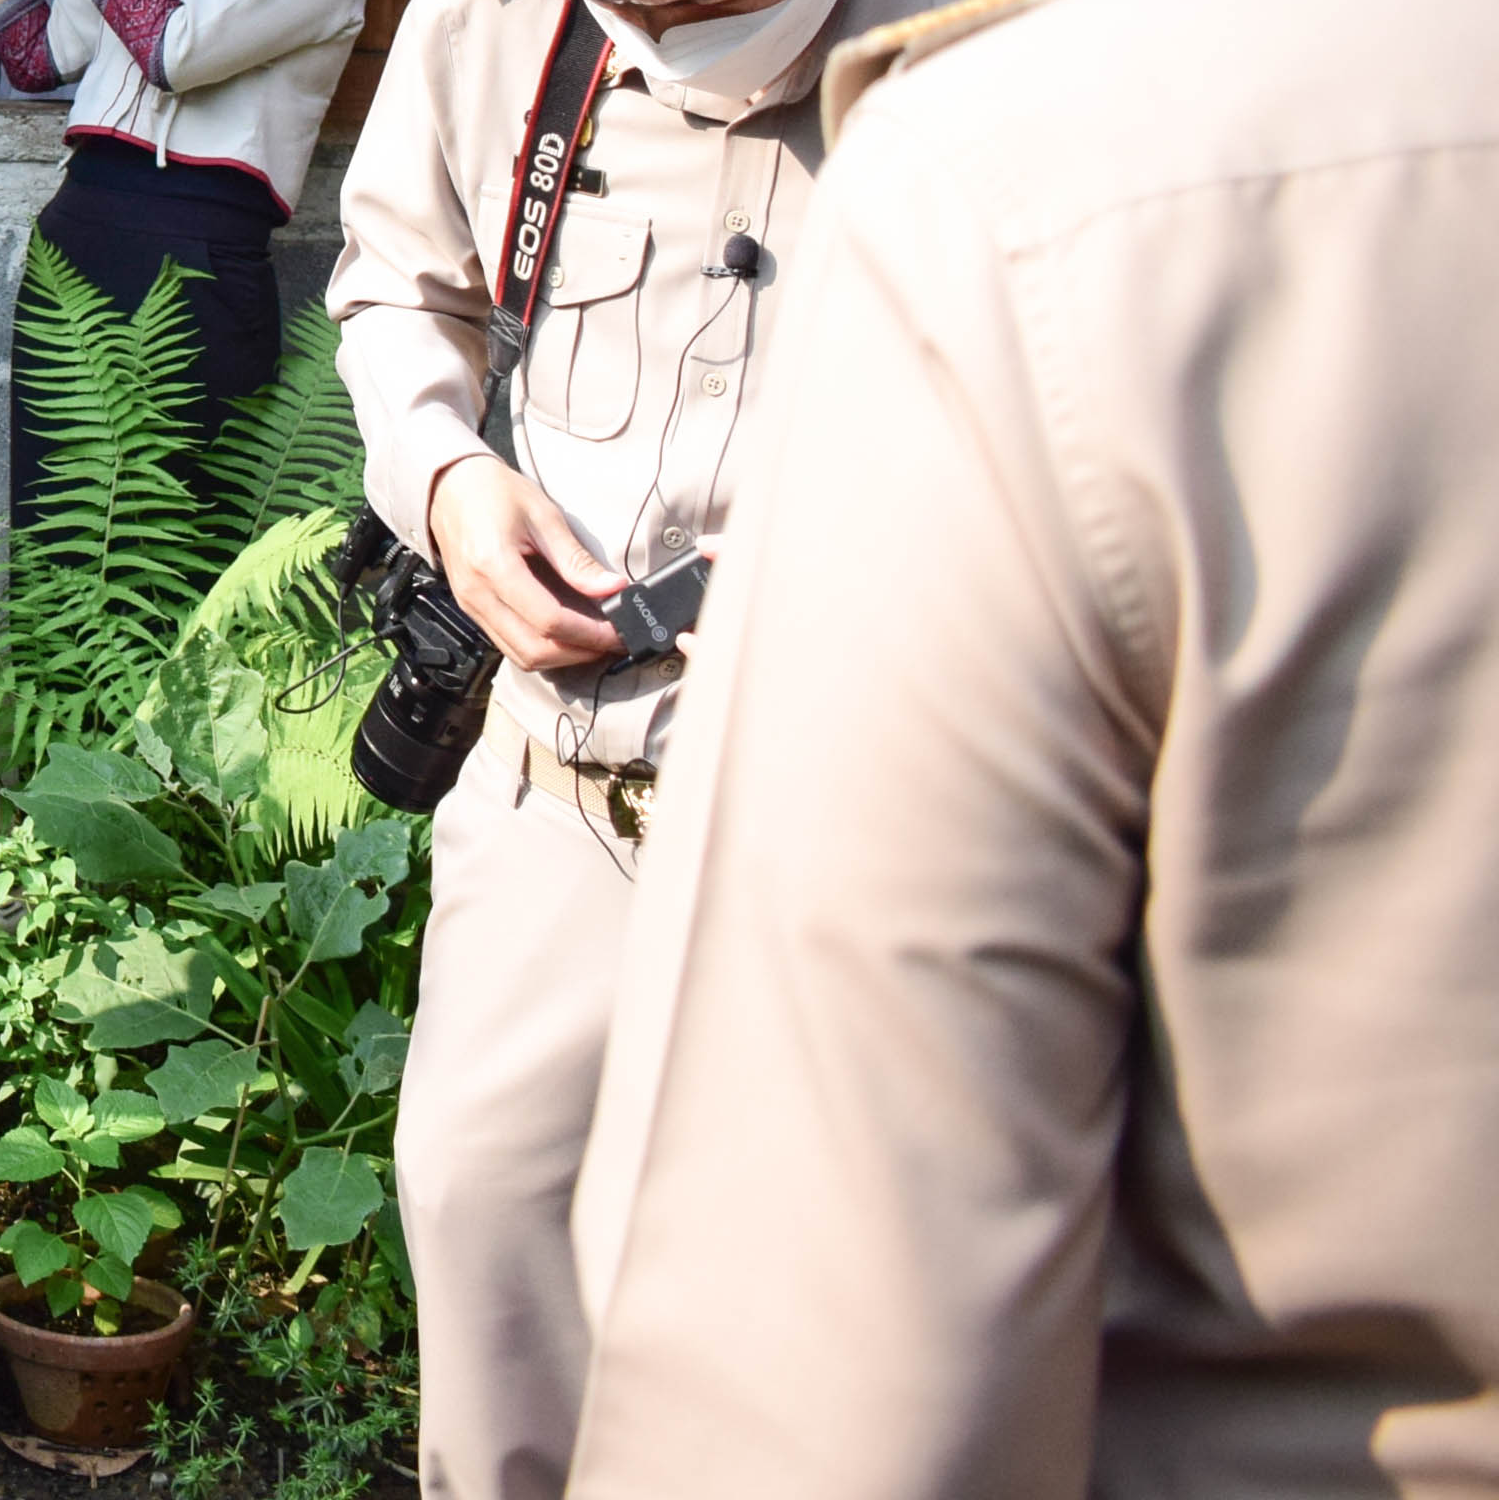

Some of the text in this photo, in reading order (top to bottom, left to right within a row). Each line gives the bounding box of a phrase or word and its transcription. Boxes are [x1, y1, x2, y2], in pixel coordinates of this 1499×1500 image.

[513, 132, 565, 281] EOS 80D
[633, 592, 658, 627] BOYA
